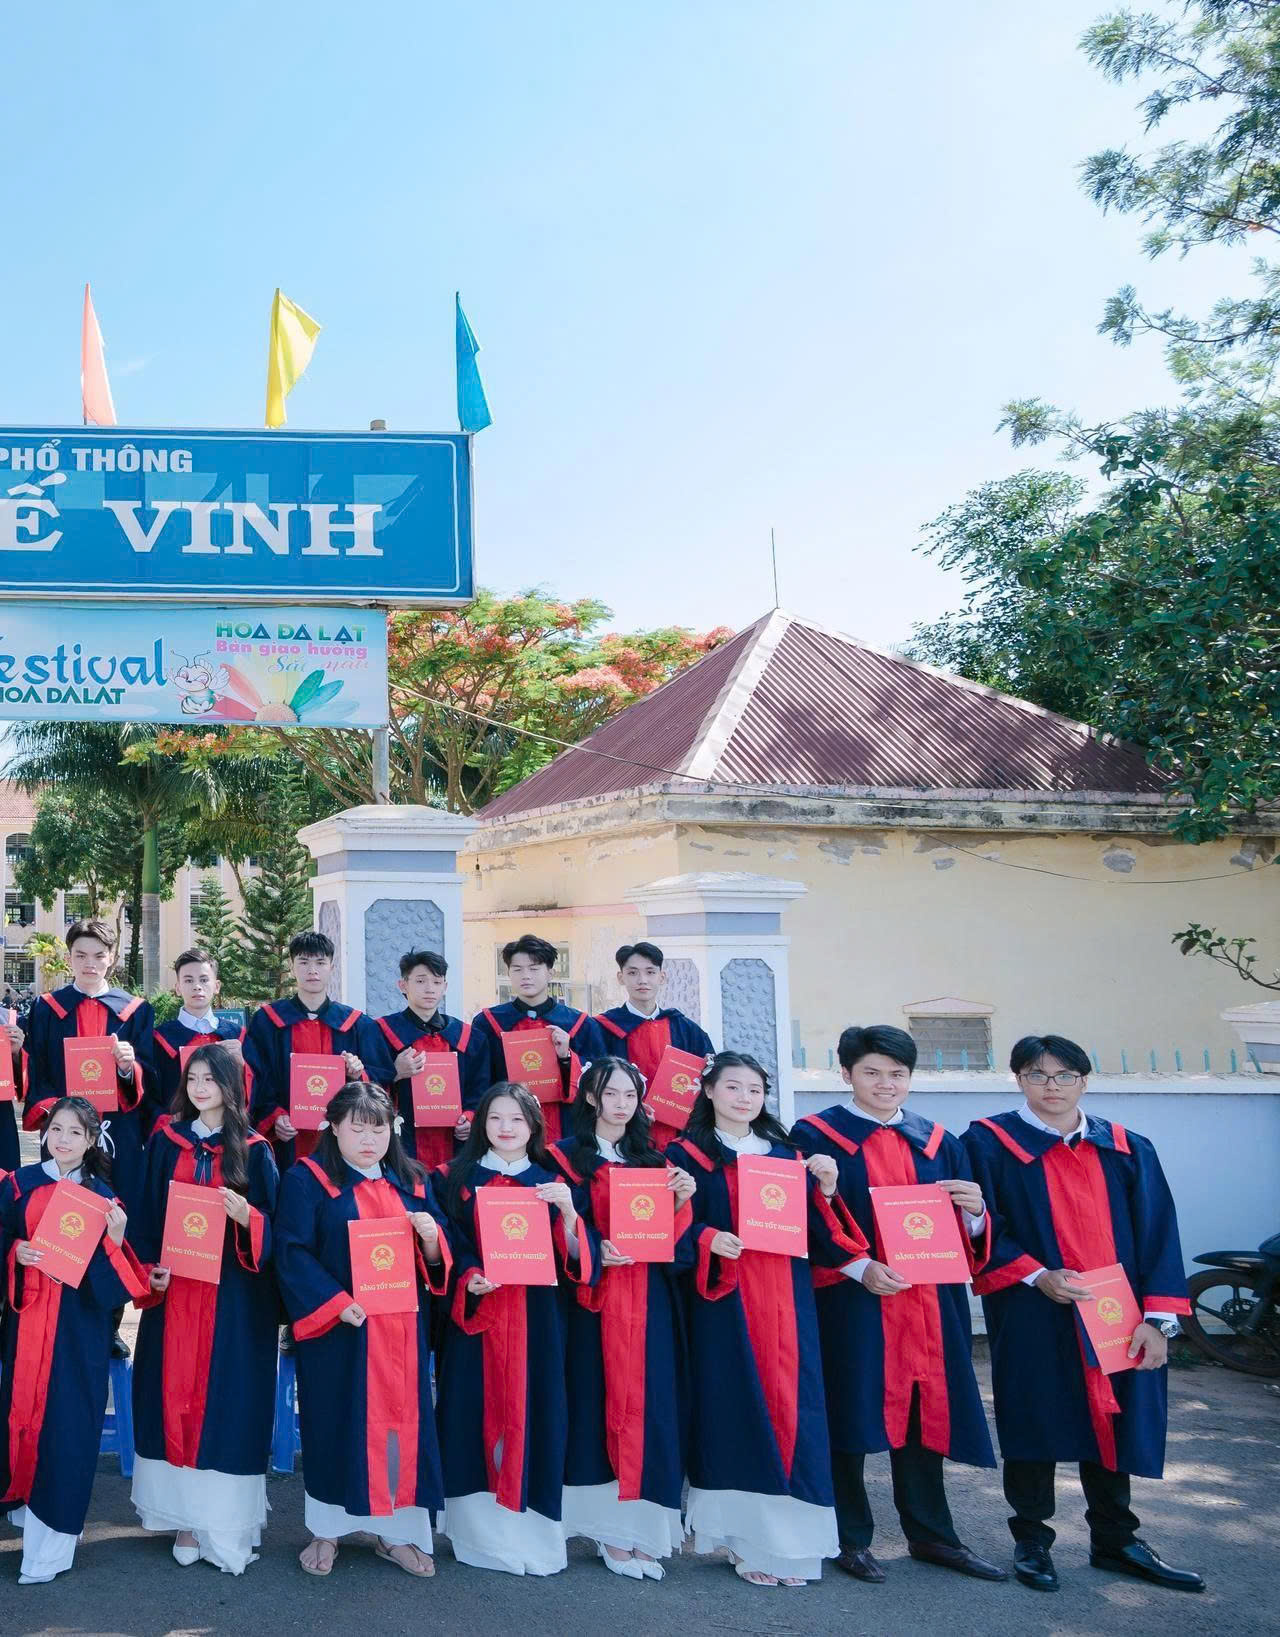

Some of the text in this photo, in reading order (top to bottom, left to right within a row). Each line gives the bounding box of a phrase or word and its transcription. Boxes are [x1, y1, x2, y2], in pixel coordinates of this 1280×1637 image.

[71, 443, 193, 473] THÔNG
[102, 500, 384, 557] VINH
[215, 622, 271, 640] HOA
[259, 641, 301, 657] giao
